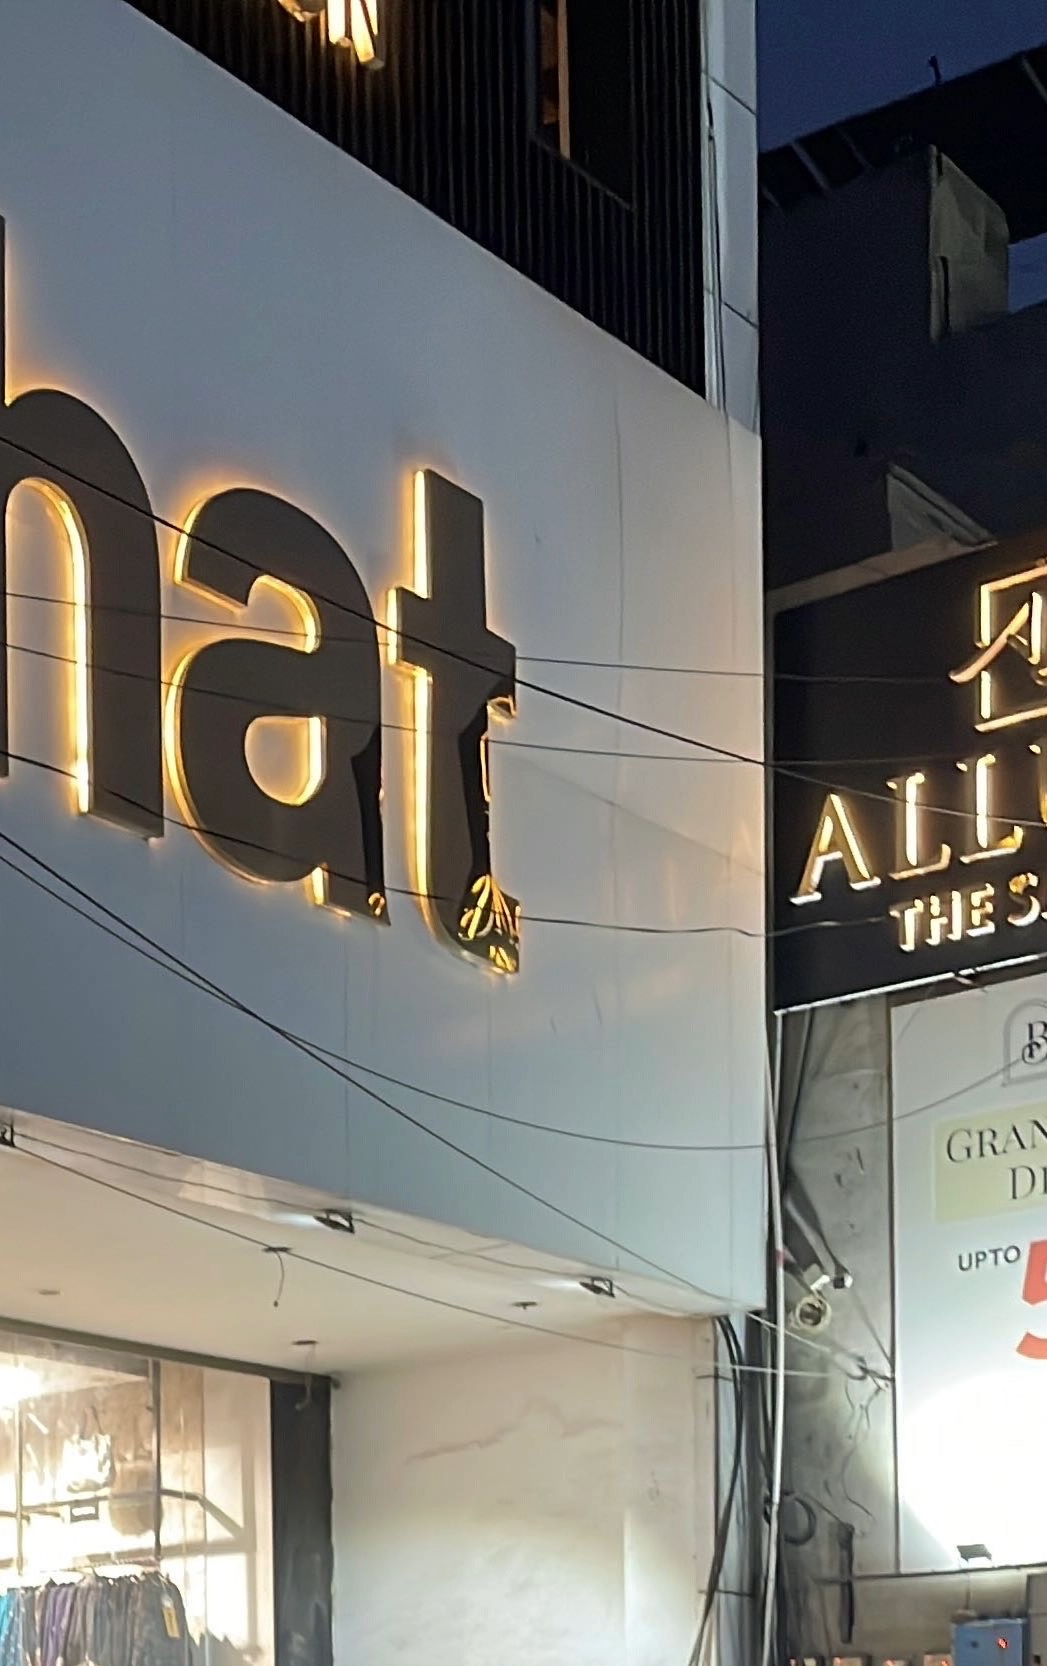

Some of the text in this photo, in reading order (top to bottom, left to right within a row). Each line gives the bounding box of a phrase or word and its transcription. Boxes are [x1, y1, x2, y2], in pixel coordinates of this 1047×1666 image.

[889, 872, 1047, 952] THE S
[958, 1245, 1021, 1272] UPTO
